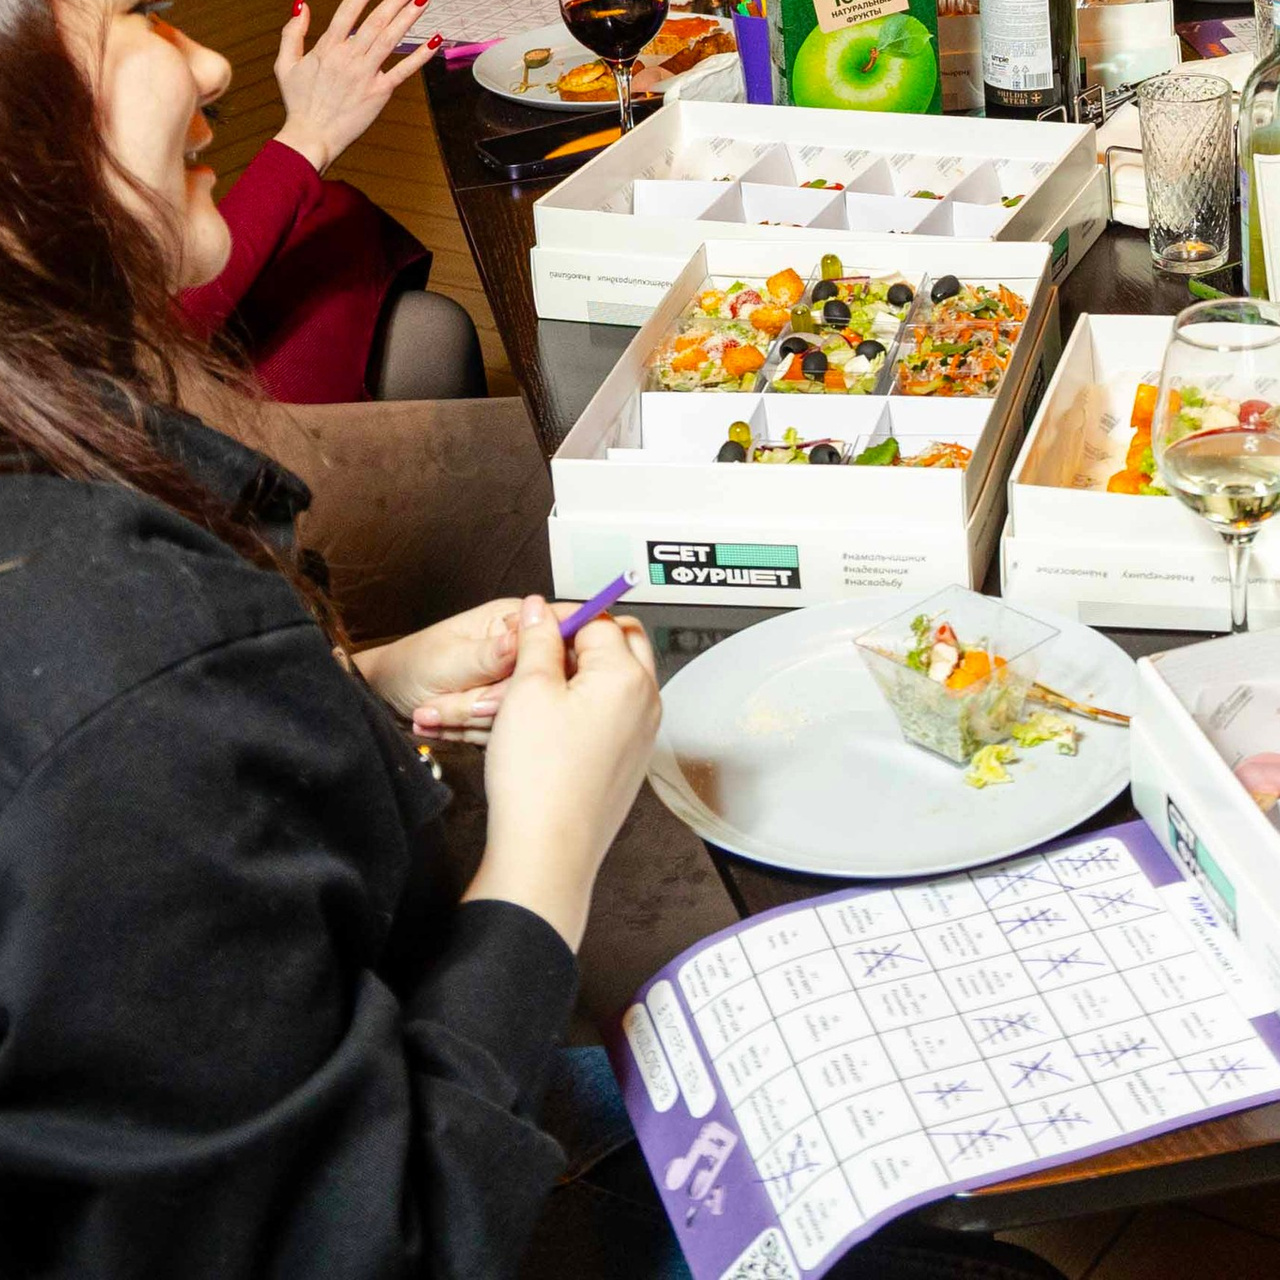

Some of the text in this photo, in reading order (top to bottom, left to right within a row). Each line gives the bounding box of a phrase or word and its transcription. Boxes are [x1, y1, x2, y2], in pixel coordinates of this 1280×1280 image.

[846, 7, 882, 25] ФРУКТЫ
[653, 544, 711, 563] СЕТ
[671, 566, 793, 586] ФУРШЕТ
